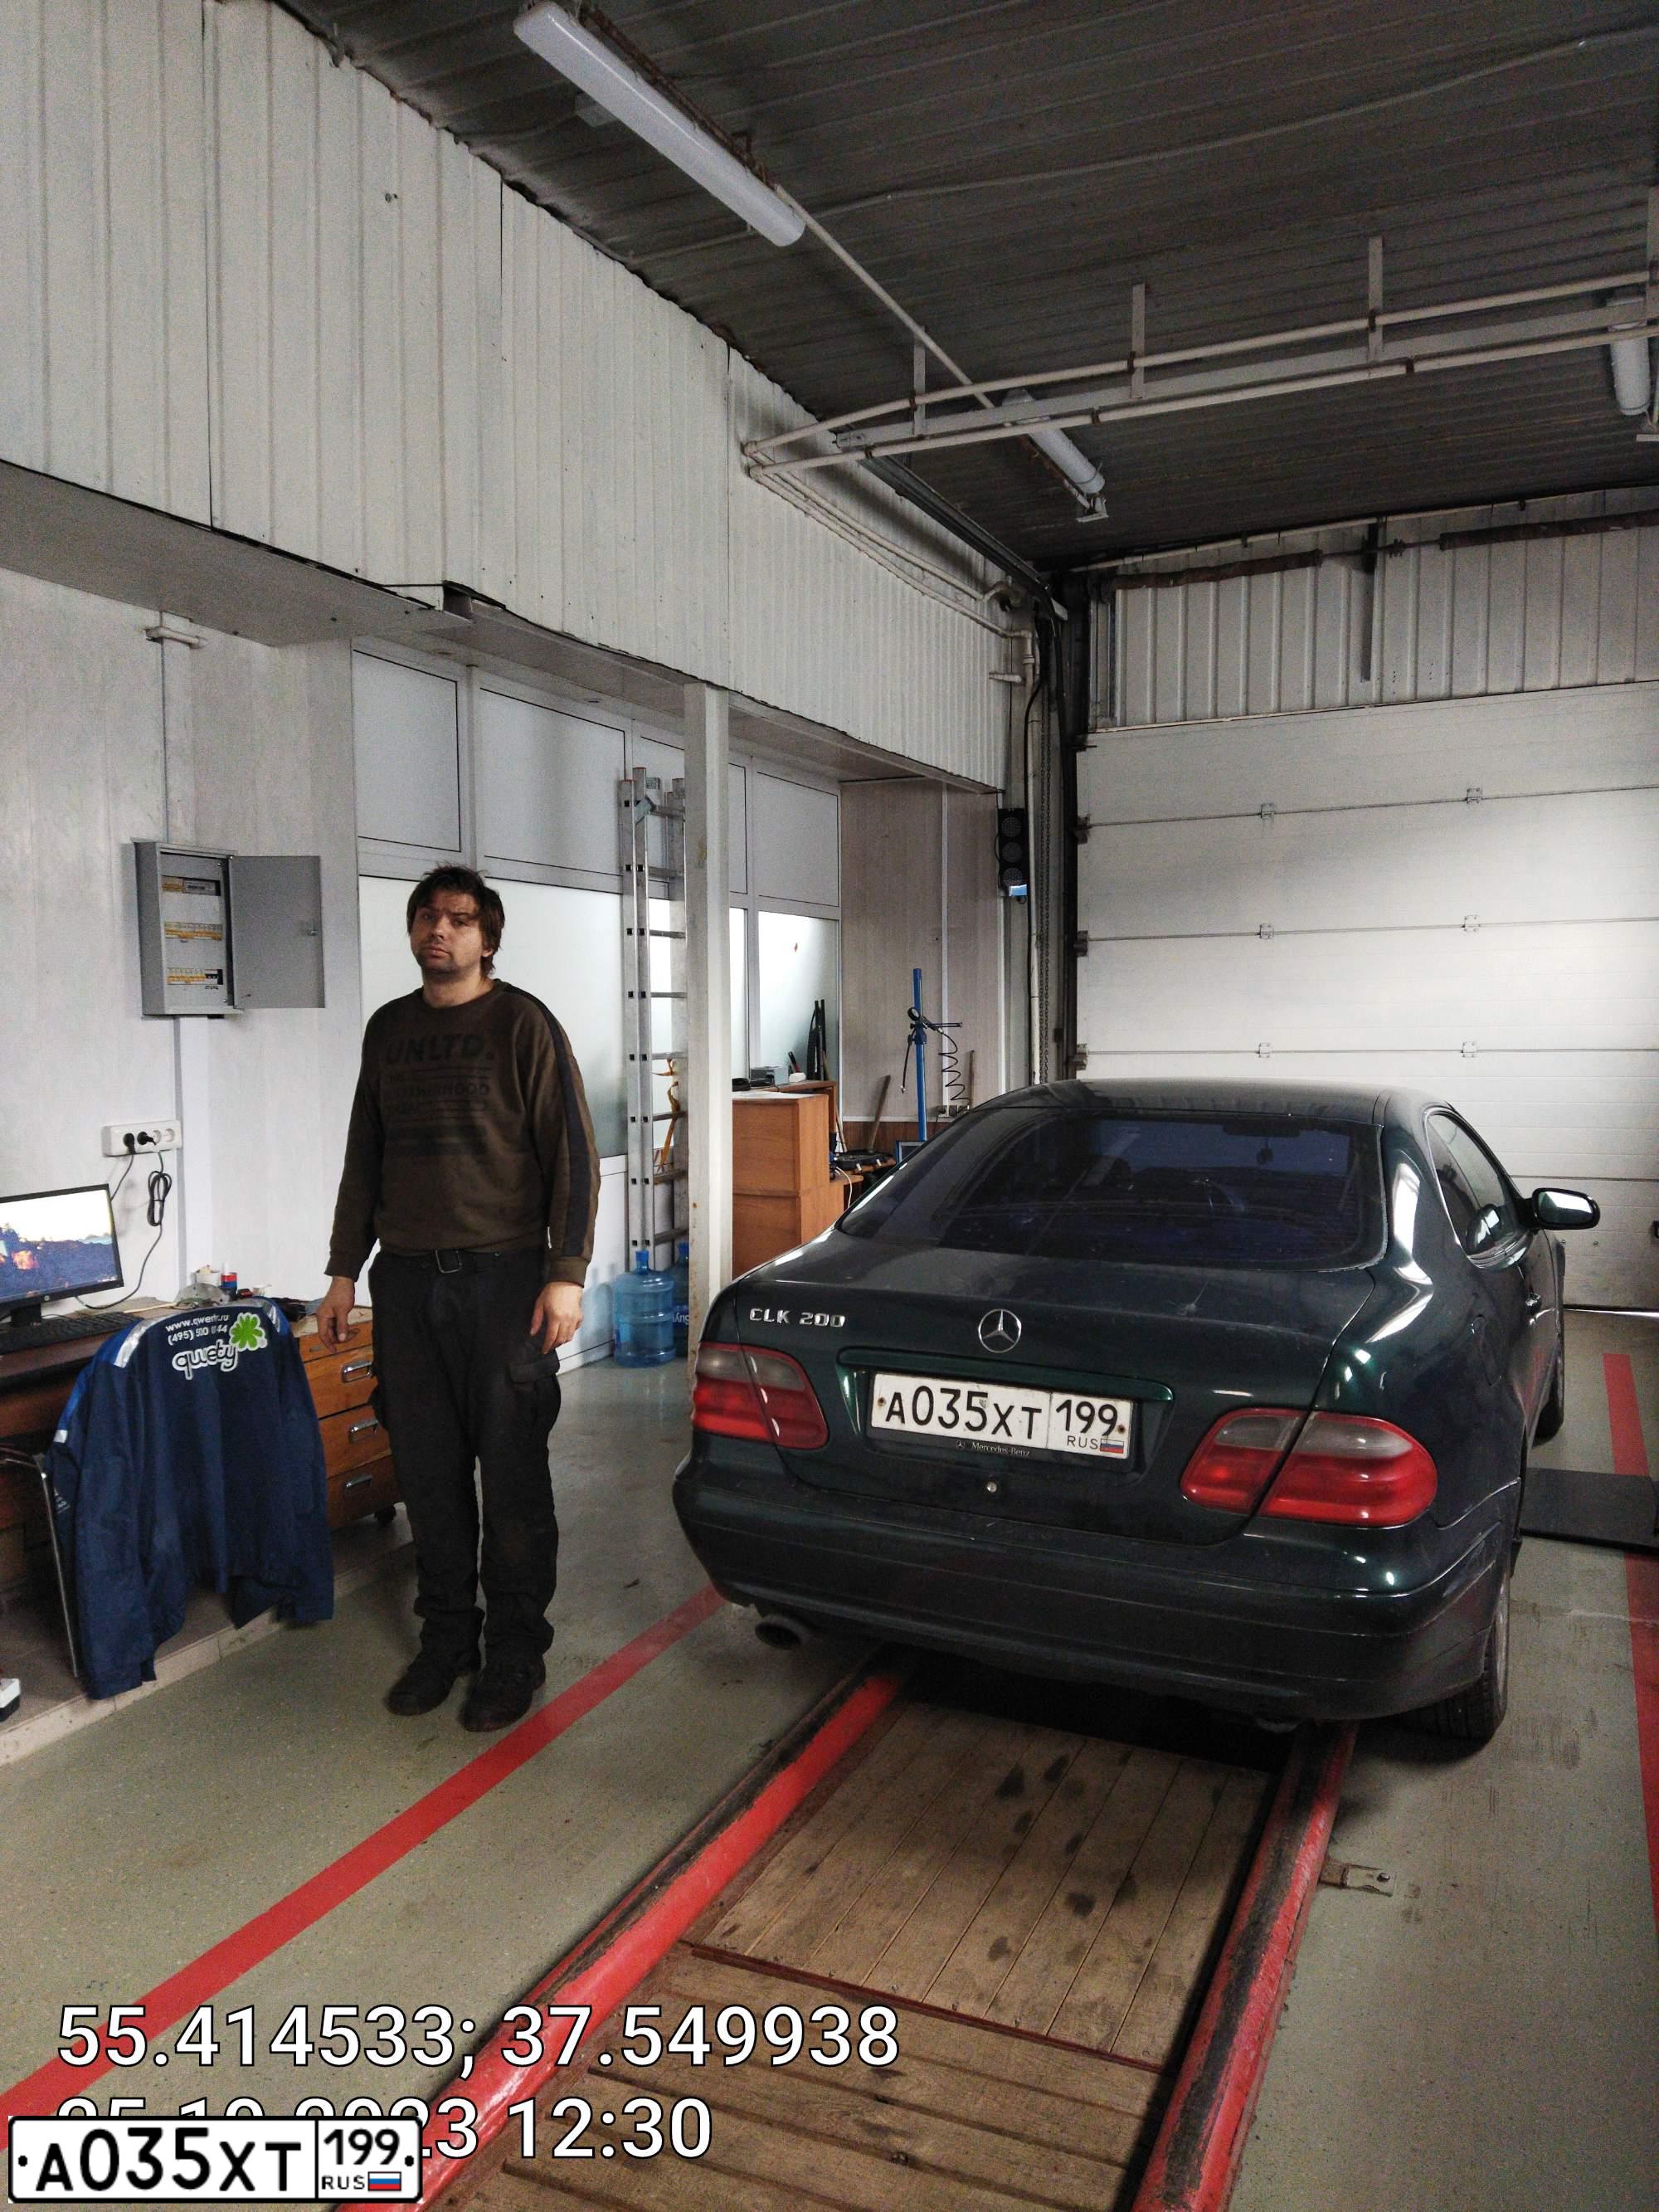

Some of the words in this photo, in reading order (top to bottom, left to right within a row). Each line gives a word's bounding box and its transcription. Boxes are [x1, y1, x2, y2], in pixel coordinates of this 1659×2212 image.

[749, 1308, 791, 1324] CLK
[799, 1312, 846, 1328] 200
[168, 1330, 194, 1346] (495)
[885, 1385, 1043, 1440] А035ХТ
[1055, 1399, 1118, 1437] 199
[1066, 1435, 1099, 1450] RUS
